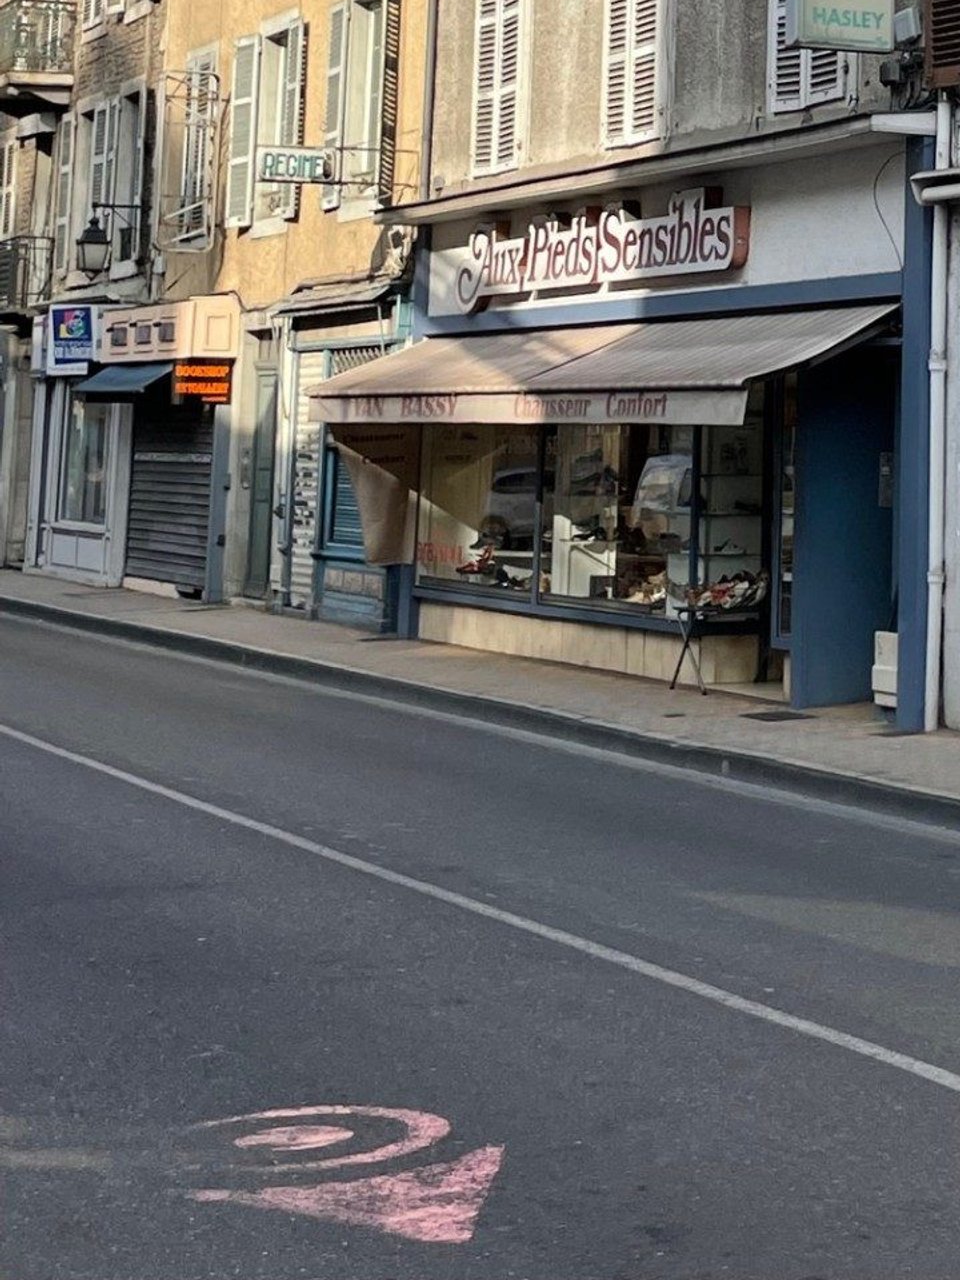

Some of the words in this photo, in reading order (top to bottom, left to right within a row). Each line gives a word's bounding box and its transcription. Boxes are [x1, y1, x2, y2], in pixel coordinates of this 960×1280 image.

[812, 6, 885, 30] HASLEY
[457, 233, 521, 304] Aux
[528, 216, 594, 281] Pieds
[600, 199, 731, 272] Sensibles
[606, 393, 668, 418] Confort
